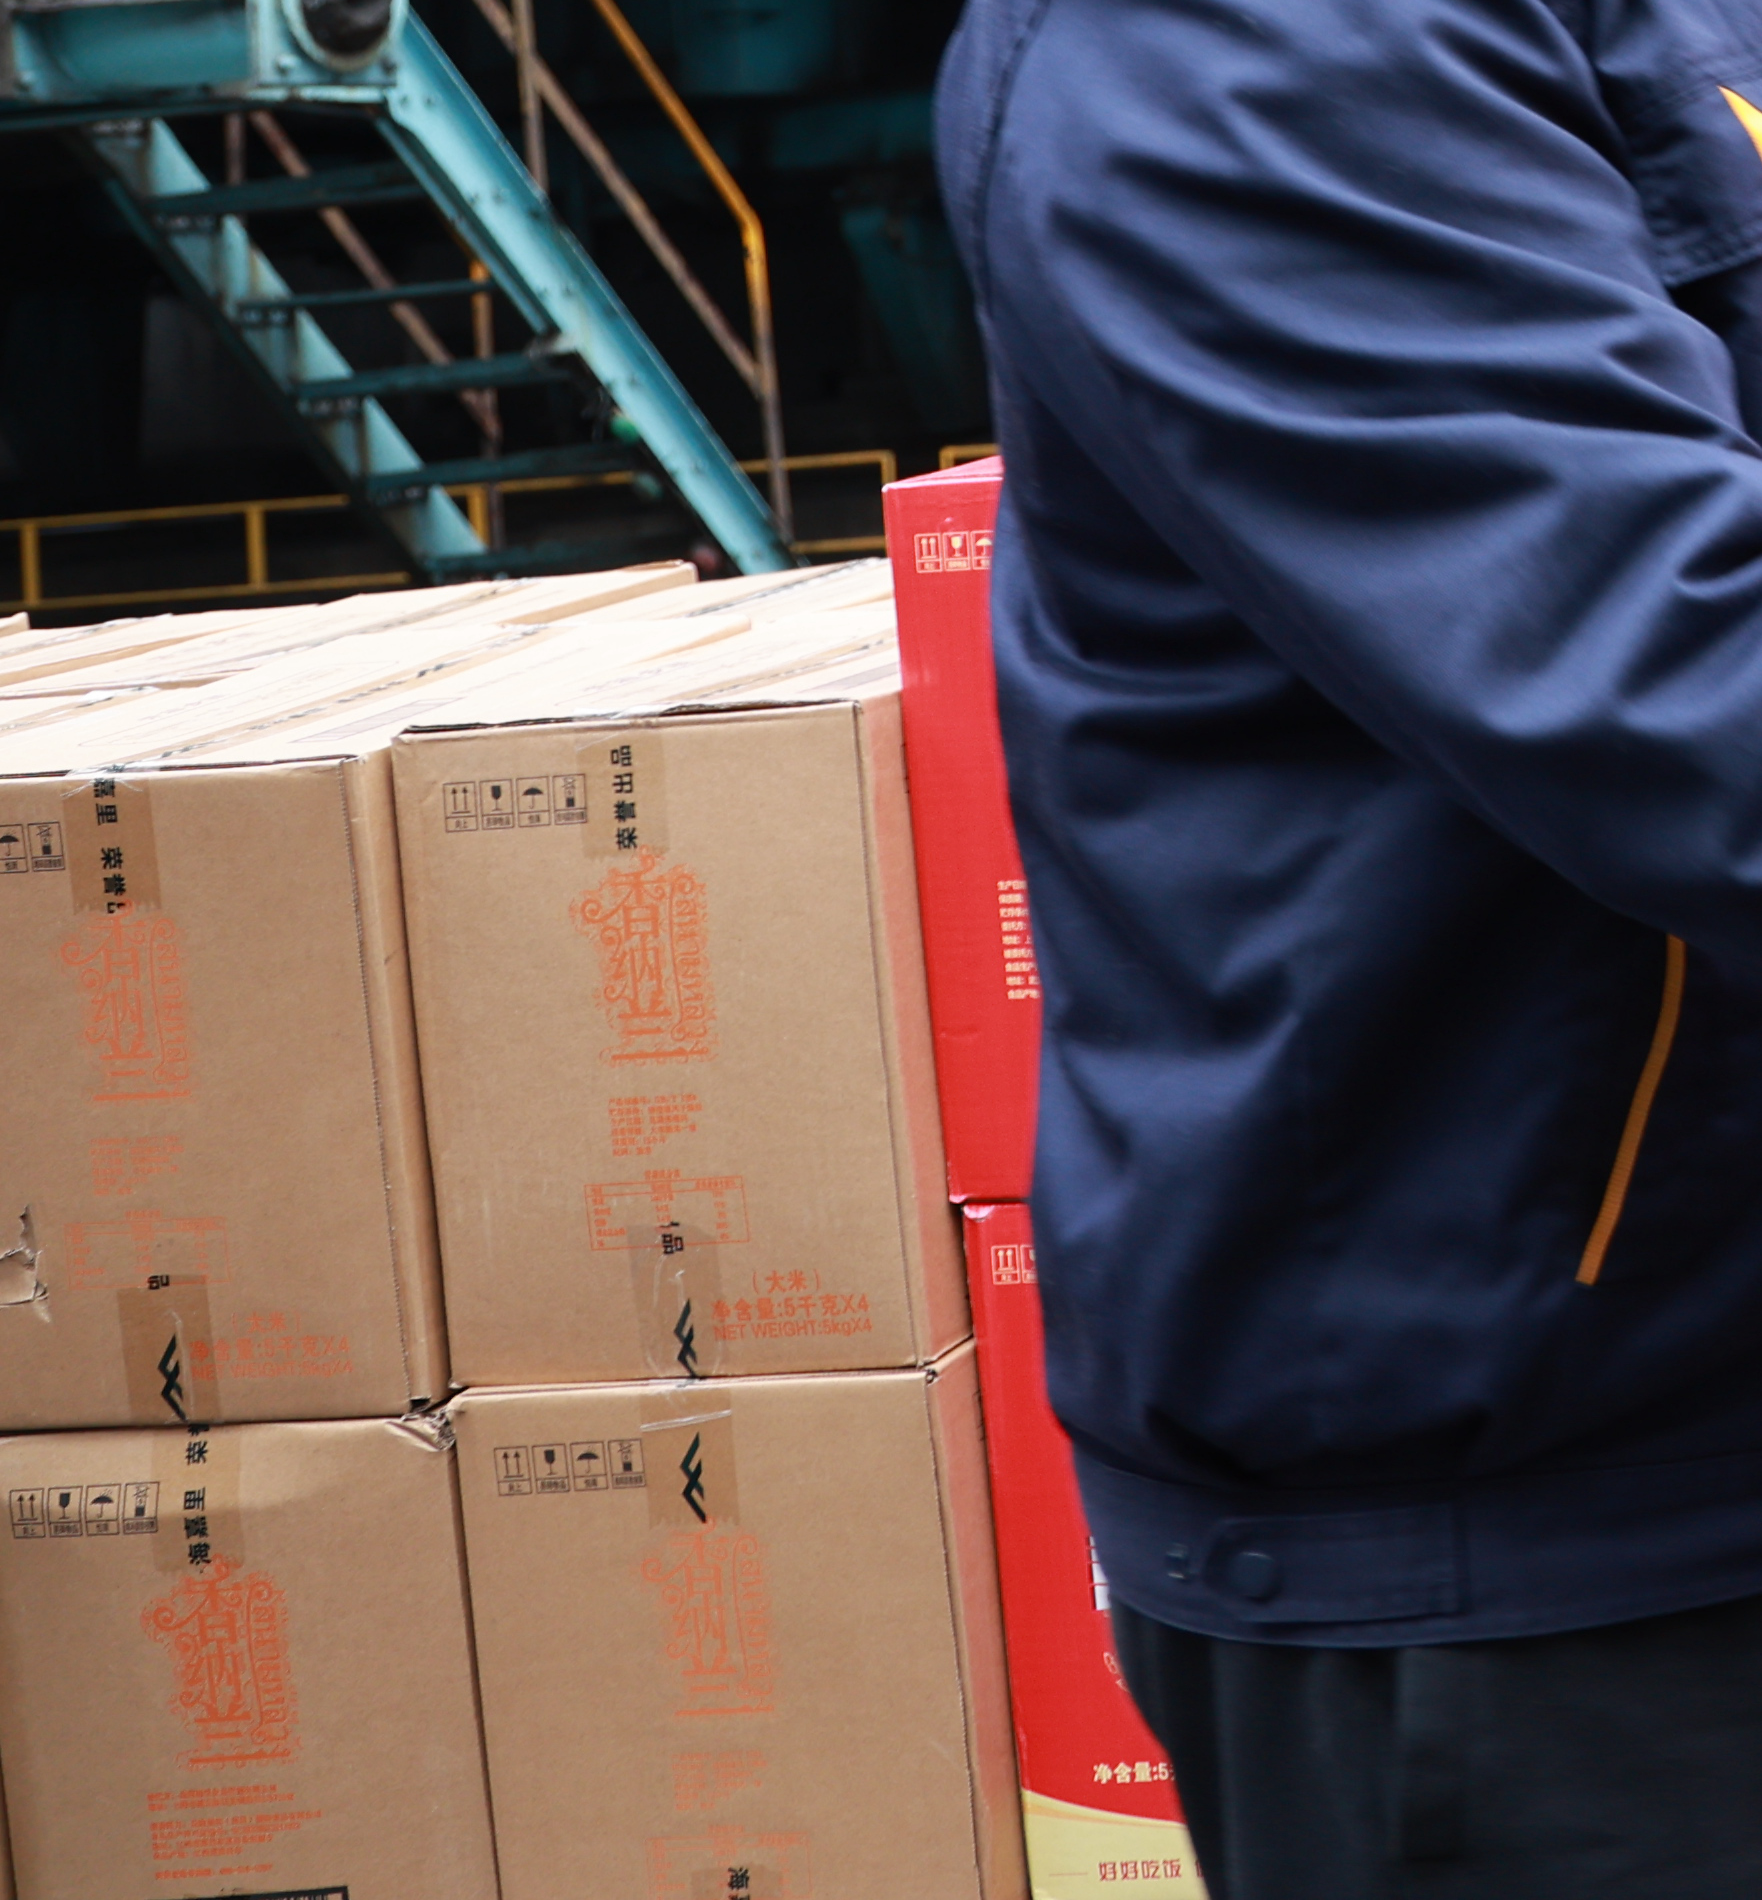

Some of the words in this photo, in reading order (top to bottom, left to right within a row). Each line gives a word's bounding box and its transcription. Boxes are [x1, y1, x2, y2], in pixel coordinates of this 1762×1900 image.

[611, 744, 638, 850] 荣誉出品
[711, 1294, 870, 1322] 净含量:5千克X4
[713, 1323, 747, 1342] NET
[752, 1318, 872, 1339] WEIGHT:5kgX4
[191, 1363, 226, 1382] NET
[184, 1487, 212, 1566] 海嘉里
[726, 1866, 751, 1900] 海
[1098, 1858, 1182, 1882] 好好吃饭
